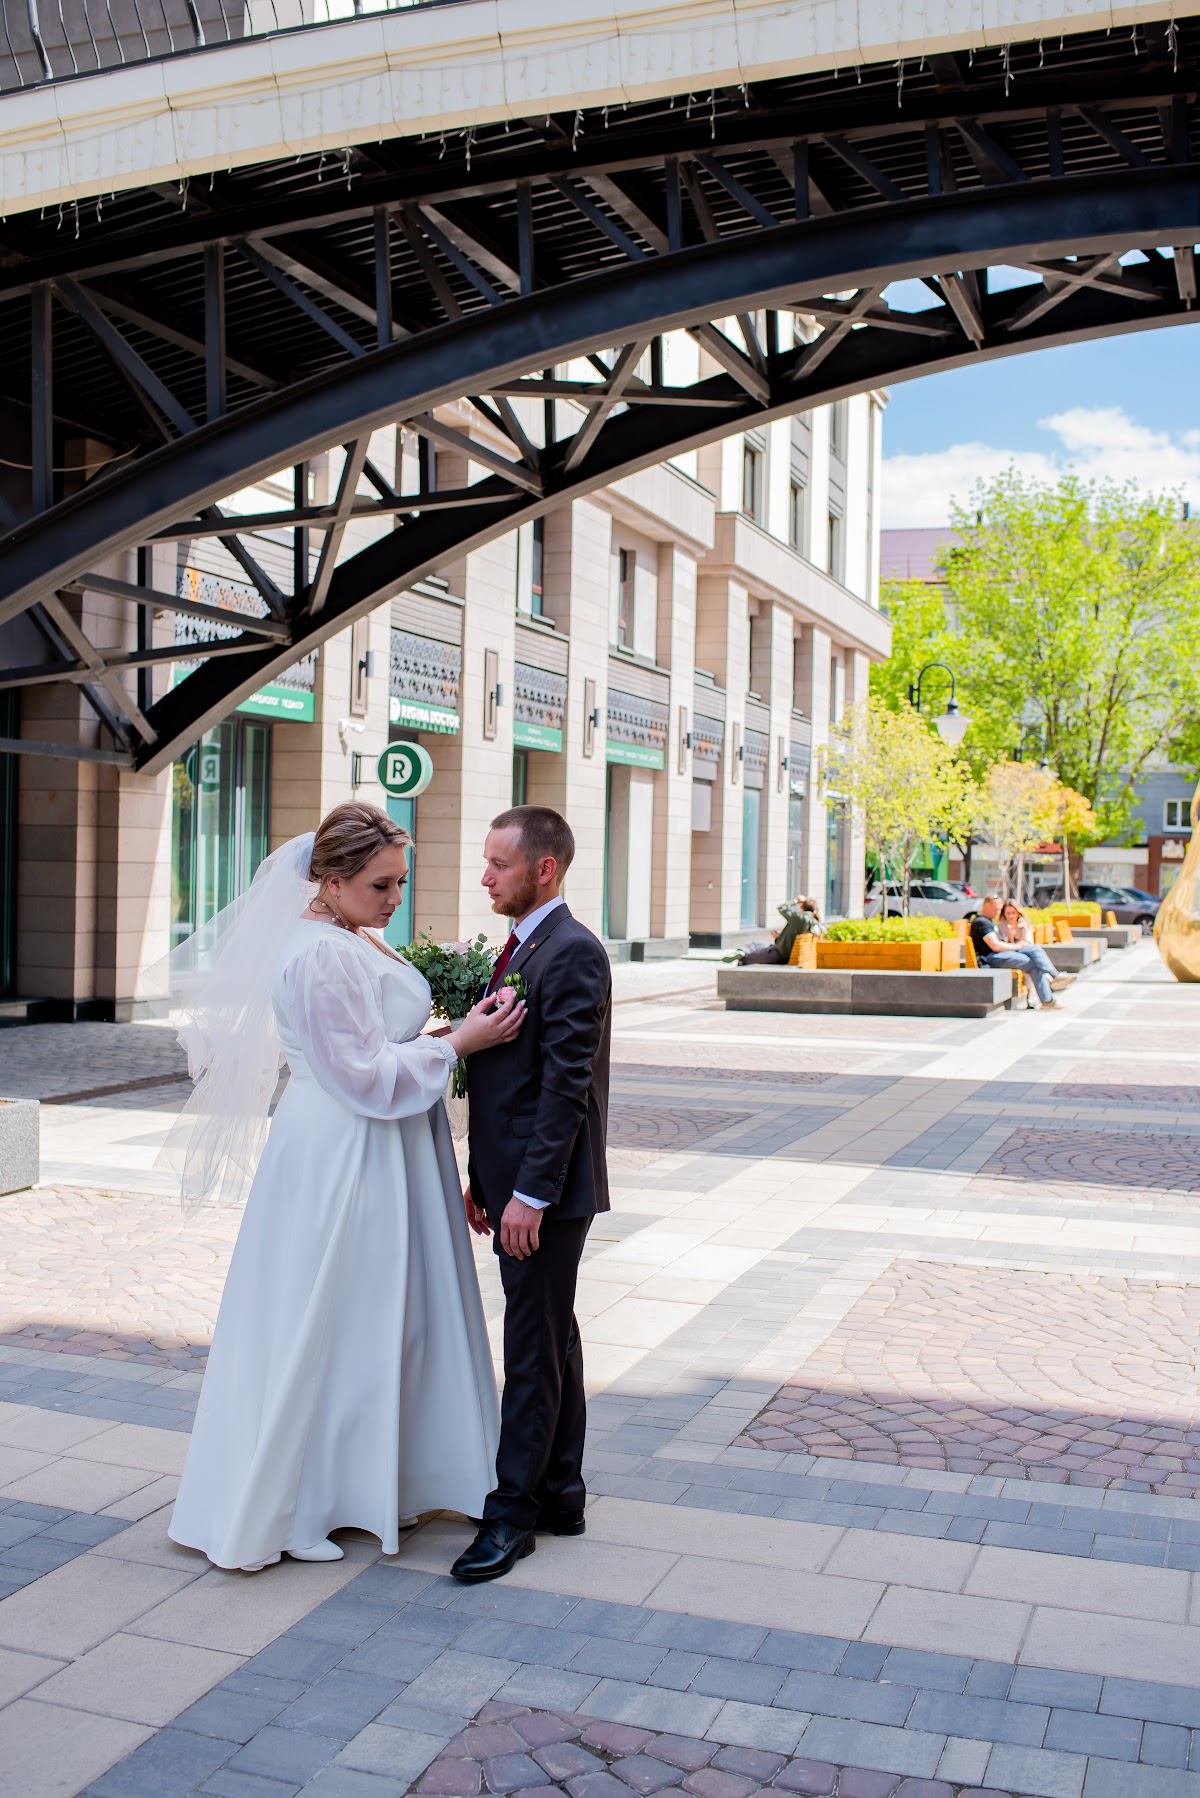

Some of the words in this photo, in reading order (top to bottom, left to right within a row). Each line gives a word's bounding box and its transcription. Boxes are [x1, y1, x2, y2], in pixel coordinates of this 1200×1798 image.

[401, 704, 430, 723] REGINA
[430, 710, 461, 729] DOCTOR
[392, 759, 405, 779] R
